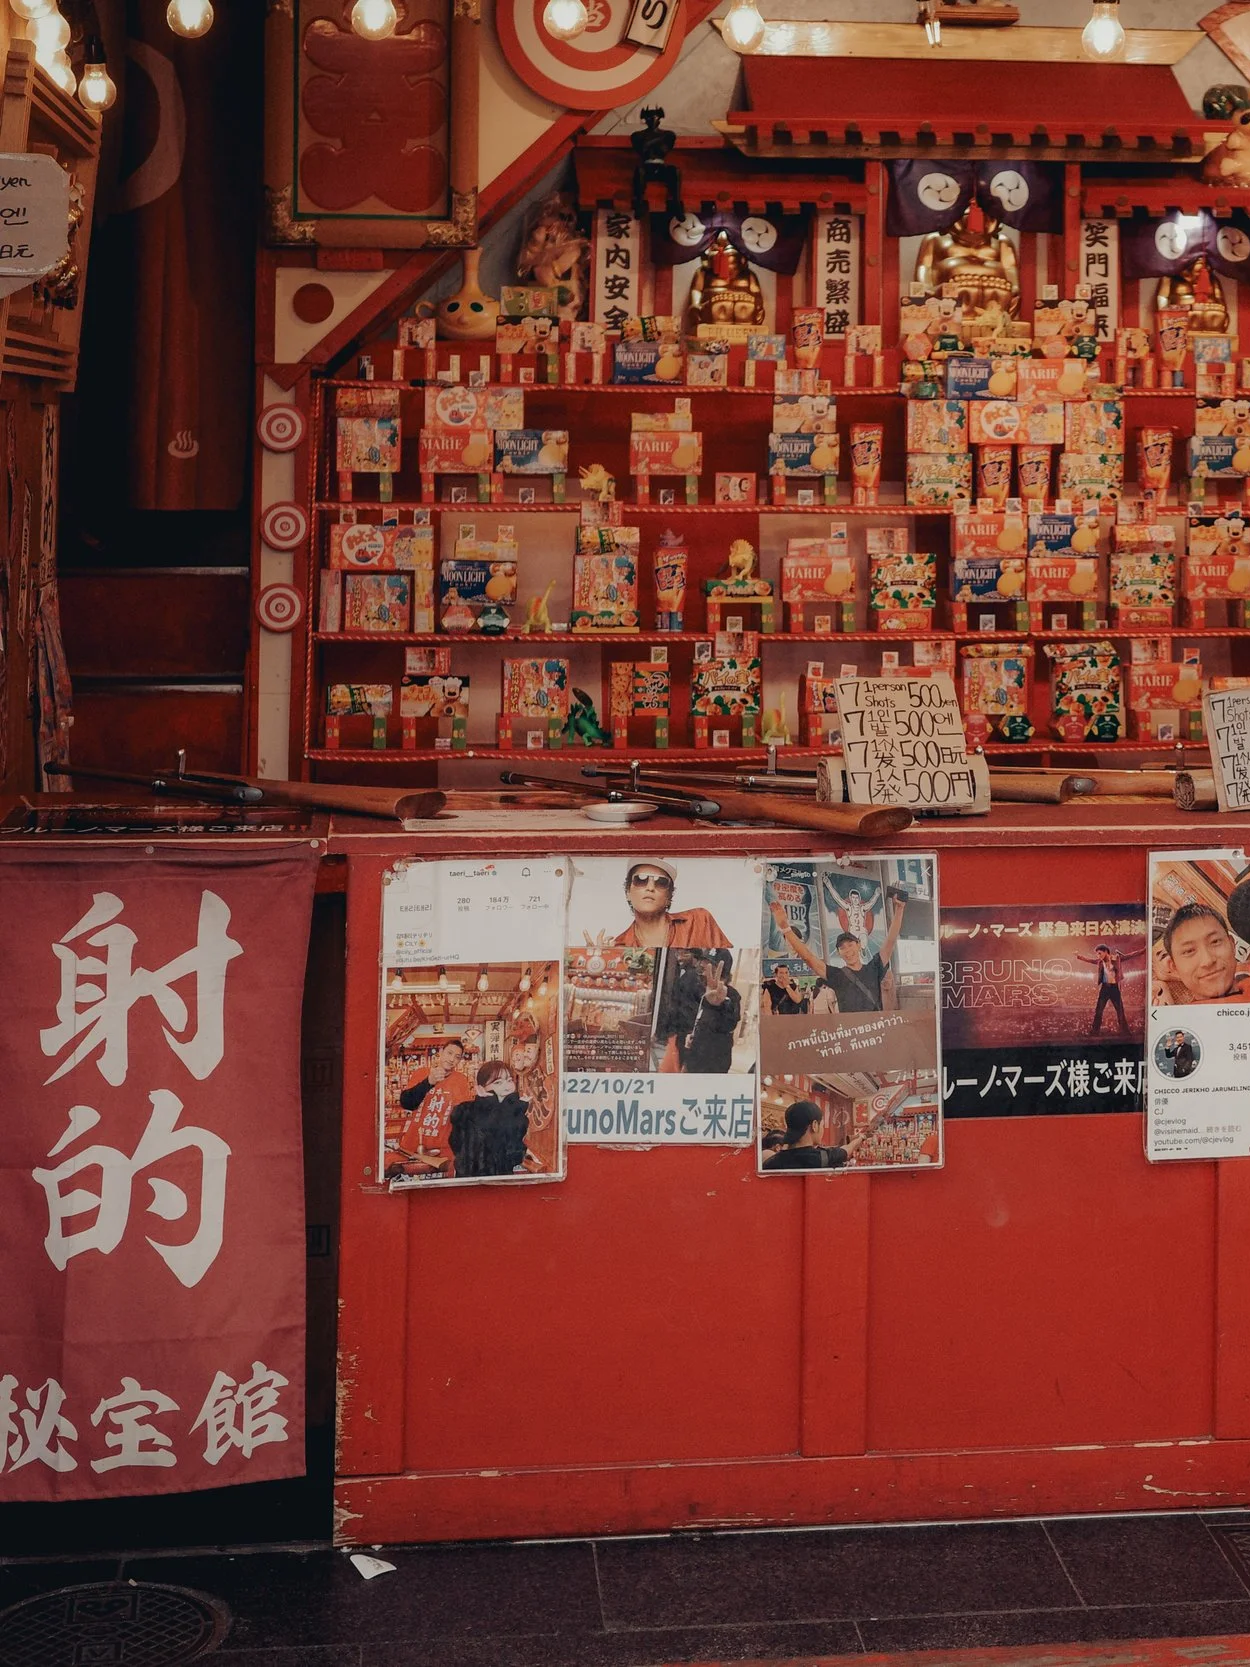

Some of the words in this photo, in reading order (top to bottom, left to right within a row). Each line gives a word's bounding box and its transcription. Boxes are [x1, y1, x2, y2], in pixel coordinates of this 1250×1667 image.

[603, 213, 632, 330] 家内安全
[825, 217, 852, 334] 商売繁盛
[423, 439, 463, 450] MARIE
[958, 524, 998, 536] MARIE
[785, 567, 826, 579] MARIE
[1030, 567, 1071, 579] MARIE
[1190, 565, 1229, 577] MARIE
[703, 670, 750, 685] パイの実
[839, 682, 860, 706] 7
[865, 696, 896, 708] Shots
[1212, 699, 1225, 722] 7
[844, 711, 865, 736] 7
[848, 741, 868, 767] 7
[875, 753, 896, 768] 发
[851, 772, 873, 804] 7
[939, 959, 1072, 984] BRUNO
[942, 984, 1058, 1009] MARS
[32, 889, 244, 1288] 射的
[0, 1360, 290, 1475] 秘宝館
